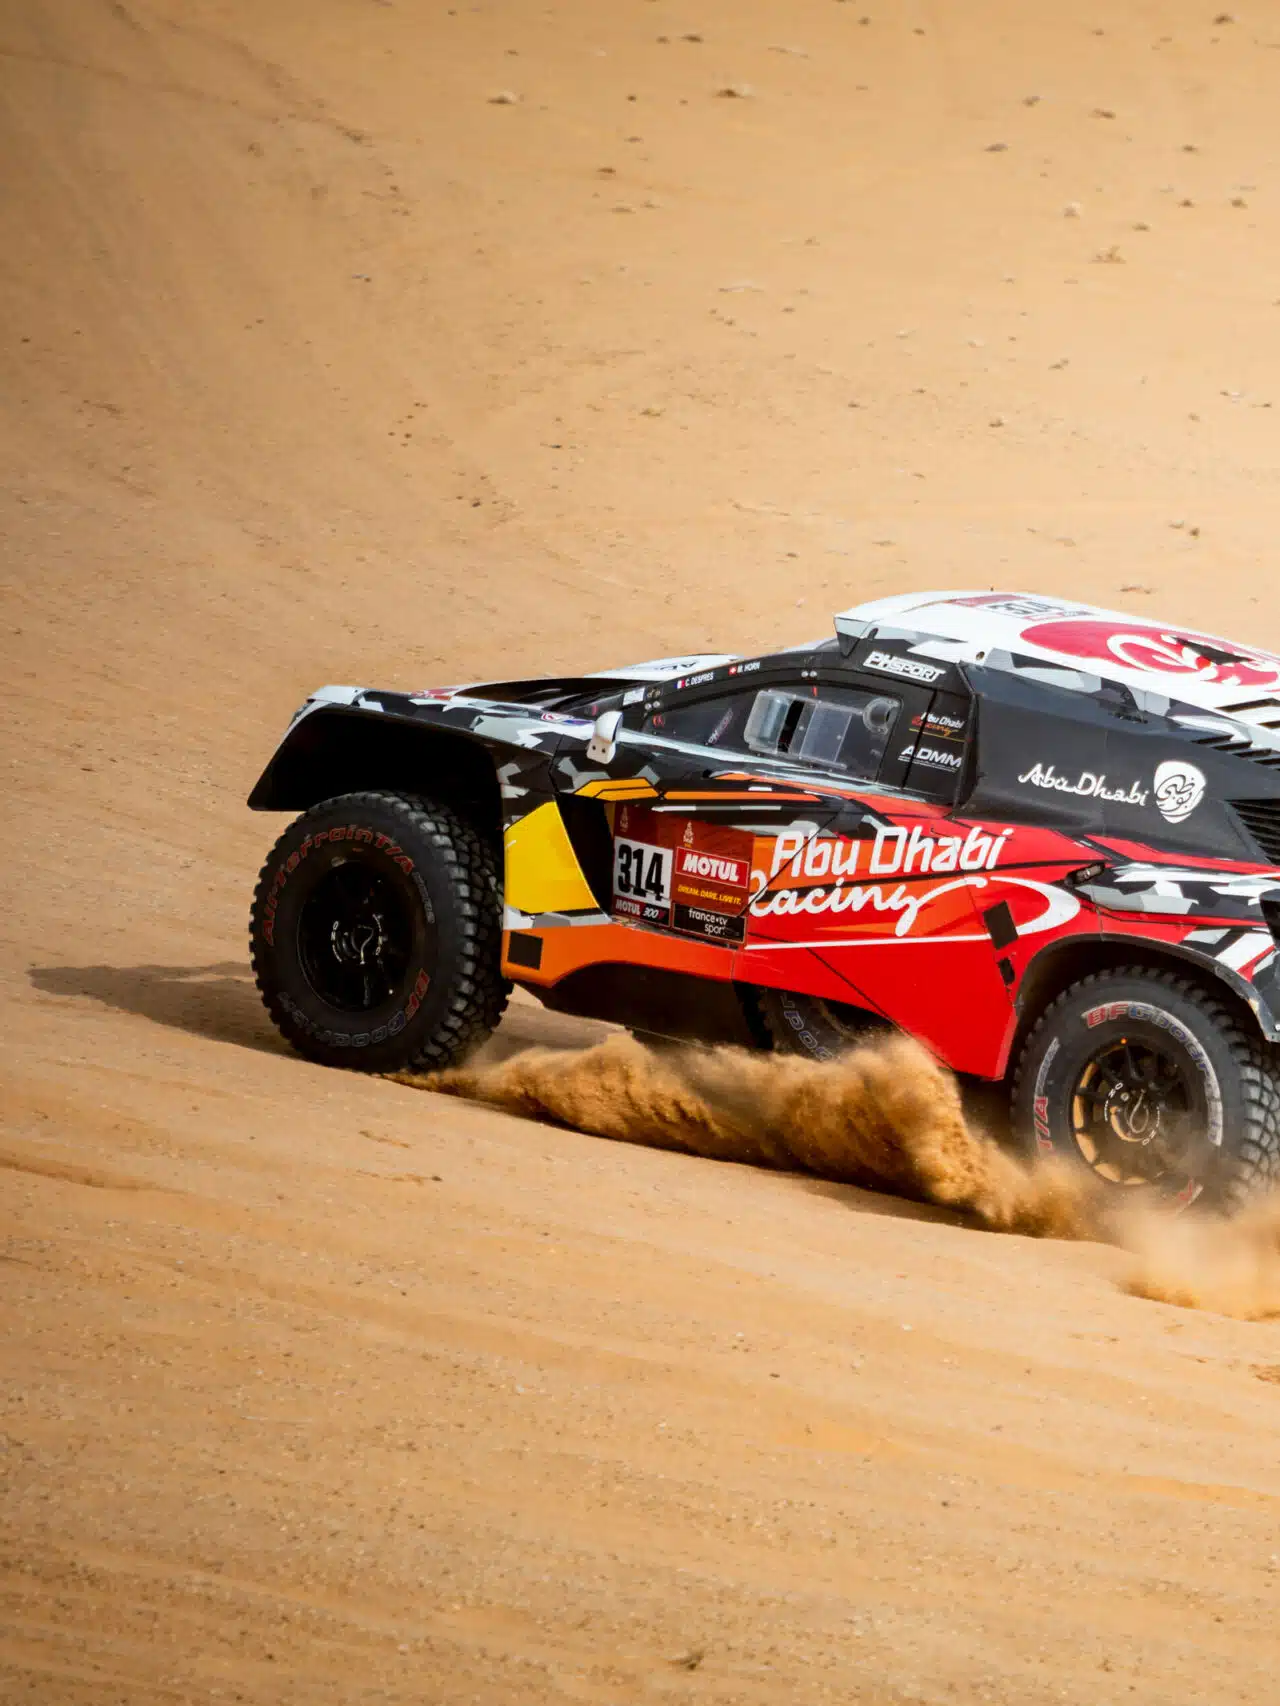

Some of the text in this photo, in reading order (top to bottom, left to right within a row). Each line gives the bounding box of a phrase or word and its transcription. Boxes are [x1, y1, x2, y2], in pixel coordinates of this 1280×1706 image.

[863, 651, 946, 682] PHSPORT
[901, 745, 962, 768] ADMM
[682, 853, 740, 882] MOTUL
[769, 826, 1014, 878] Abu Dhabi
[618, 844, 664, 901] 314
[615, 899, 641, 916] MOTUL
[748, 868, 988, 937] Racing
